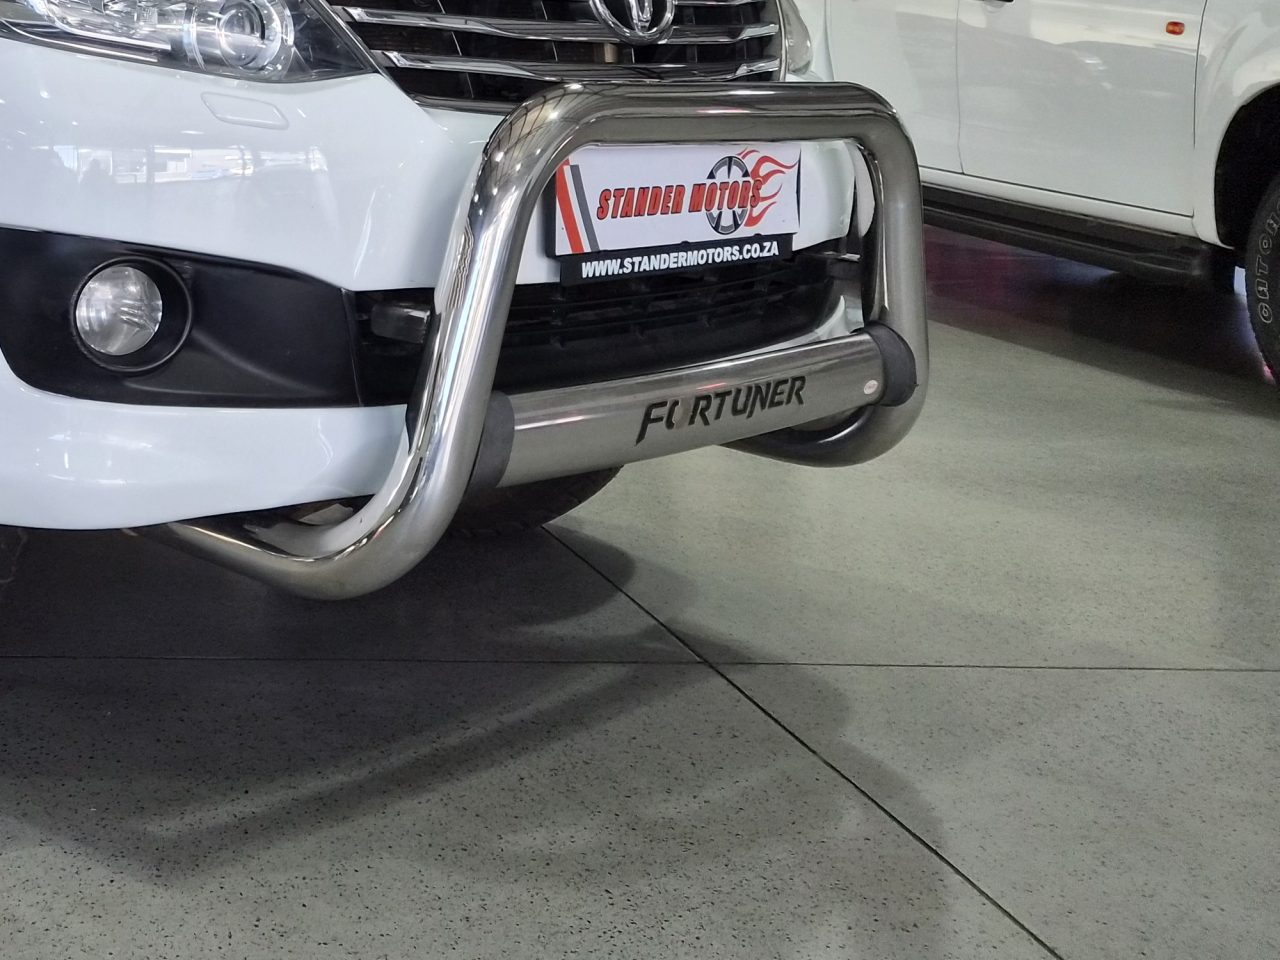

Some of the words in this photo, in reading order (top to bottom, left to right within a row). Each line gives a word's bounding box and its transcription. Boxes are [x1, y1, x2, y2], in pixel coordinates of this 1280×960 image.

[597, 184, 686, 220] STANDER
[688, 179, 763, 213] MOTORS
[581, 240, 780, 279] WWW.STANDERMOTORS.CO.ZA
[635, 375, 807, 447] FORTUNER
